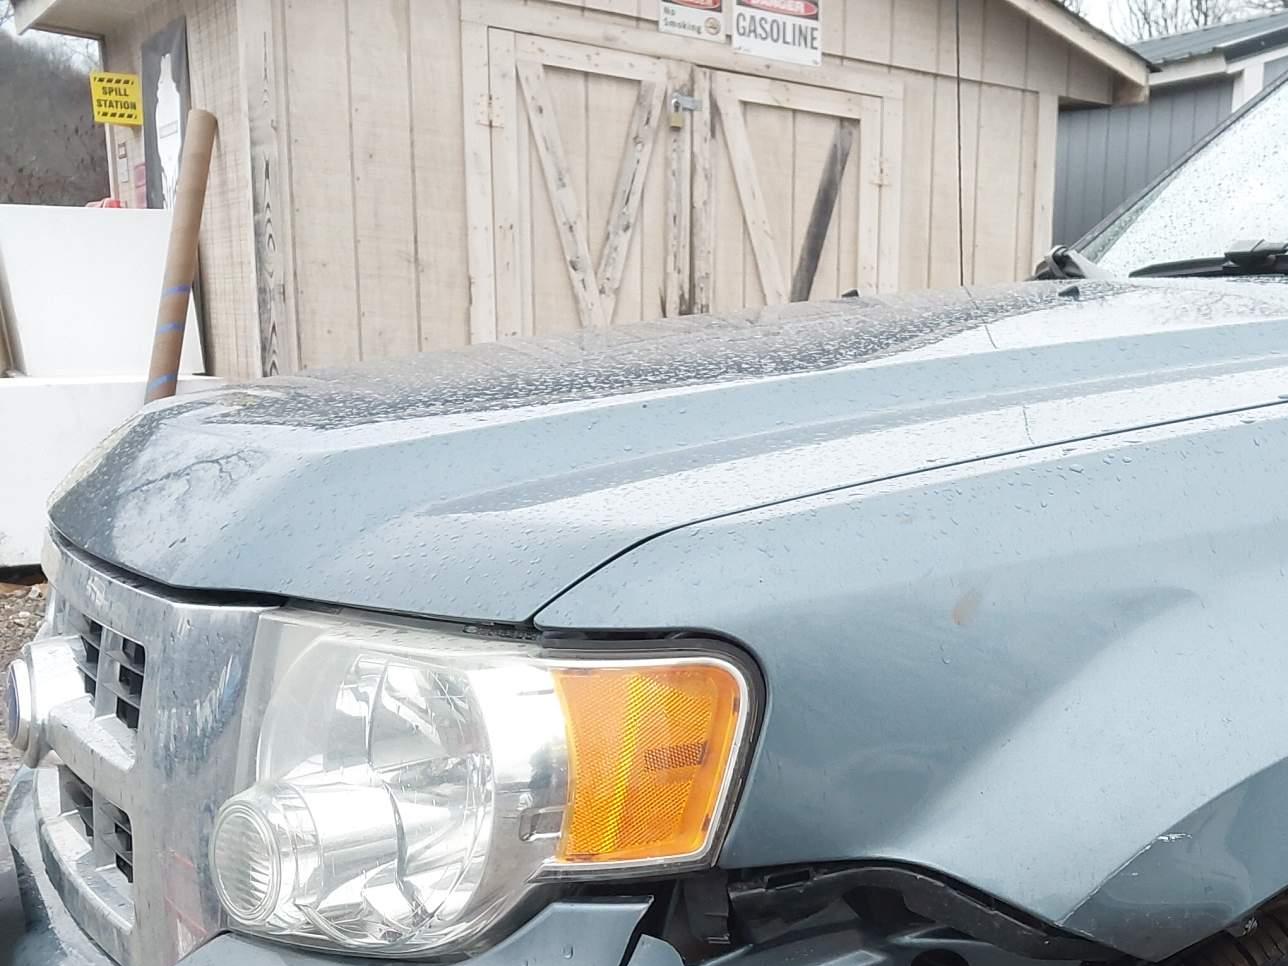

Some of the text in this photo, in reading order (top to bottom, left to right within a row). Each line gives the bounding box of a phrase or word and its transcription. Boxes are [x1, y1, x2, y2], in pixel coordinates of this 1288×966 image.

[663, 17, 702, 34] Smoking
[736, 12, 819, 50] GASOLINE
[102, 86, 129, 97] SPILL
[96, 98, 137, 111] STATION
